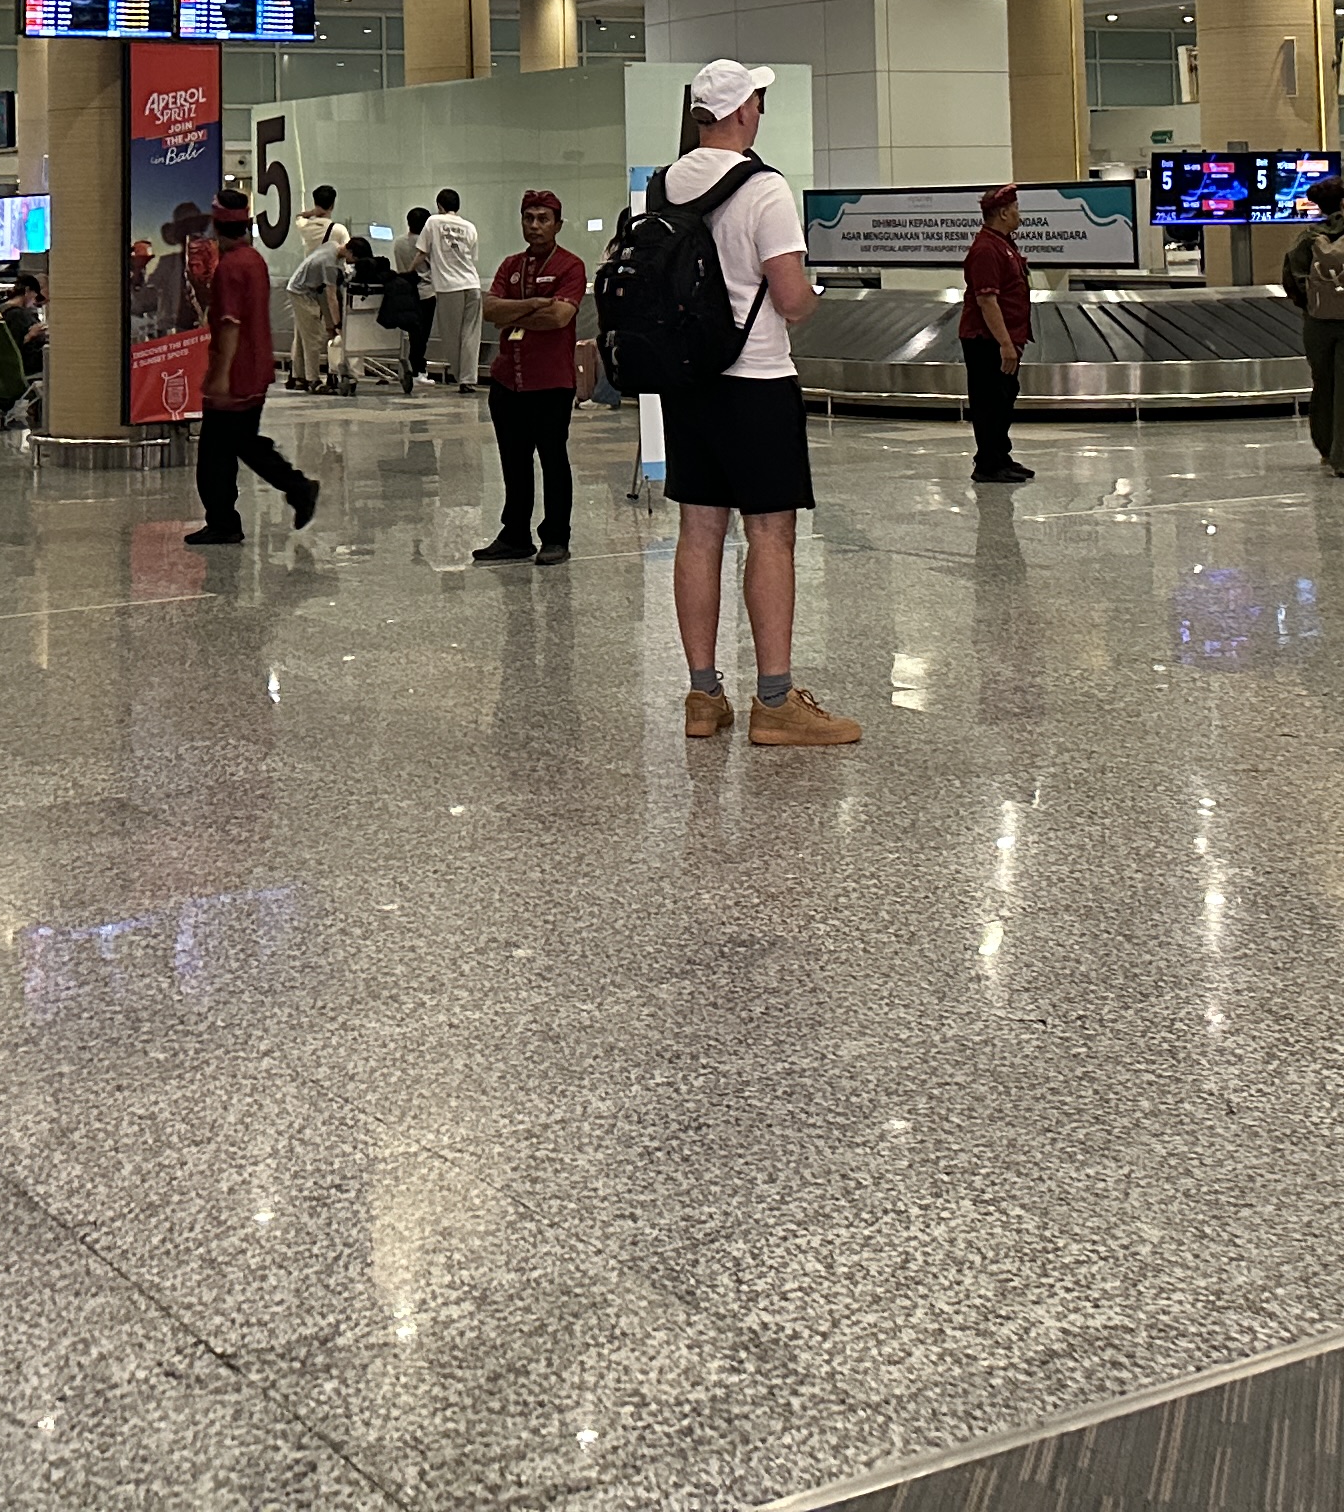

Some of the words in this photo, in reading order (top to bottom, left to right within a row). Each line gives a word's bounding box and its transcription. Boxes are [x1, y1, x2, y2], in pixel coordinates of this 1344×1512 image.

[144, 86, 207, 116] APEROL
[167, 120, 193, 134] JOIN
[164, 134, 184, 147] THE
[184, 129, 205, 143] JOY
[164, 141, 206, 166] Bali
[256, 115, 292, 249] 5
[1161, 170, 1173, 190] 5
[1256, 169, 1267, 190] 5
[908, 218, 939, 228] KEPADA
[841, 232, 862, 241] AGAR
[862, 231, 921, 241] MENGGUNAKAN
[921, 231, 944, 241] TAKSI
[944, 231, 969, 241] RESMI
[1044, 230, 1088, 241] BANDARA
